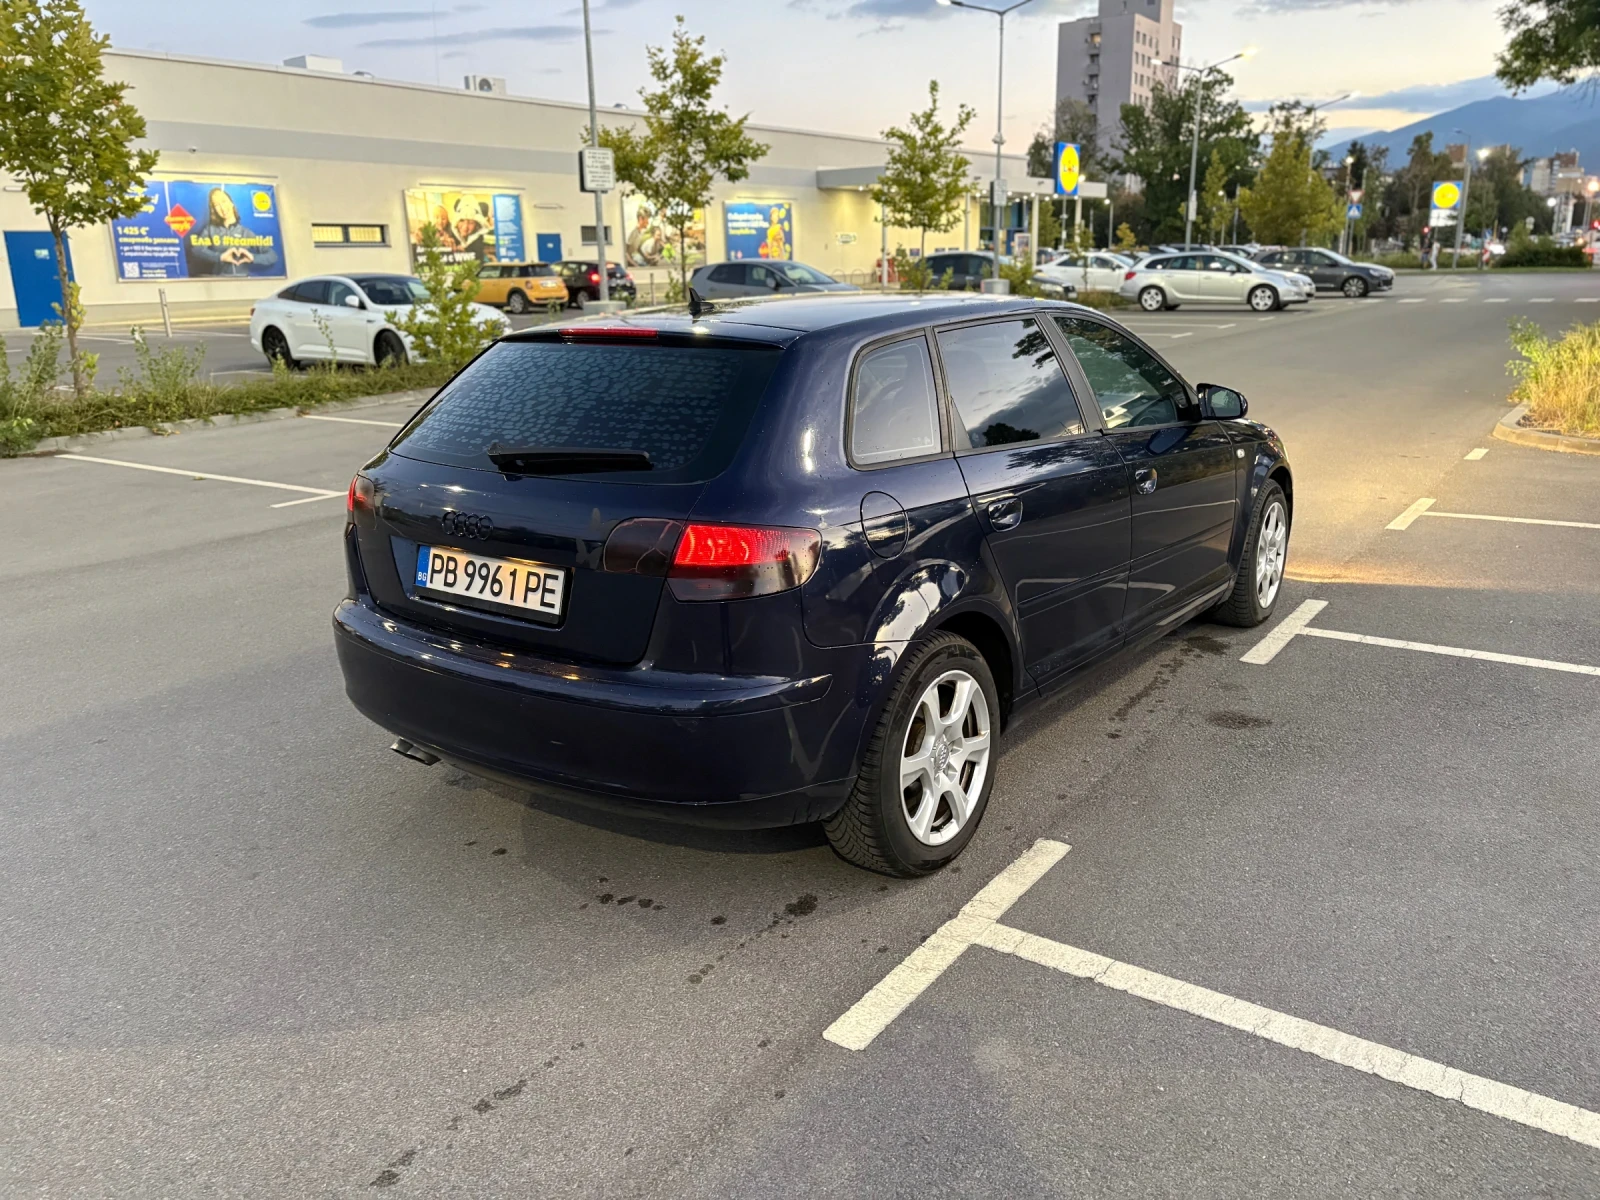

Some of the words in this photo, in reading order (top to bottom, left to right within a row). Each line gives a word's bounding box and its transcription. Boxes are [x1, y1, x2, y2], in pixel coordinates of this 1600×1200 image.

[190, 235, 213, 247] Ела
[223, 235, 273, 247] #teamlidl
[417, 571, 427, 582] BG
[429, 553, 458, 588] PB
[464, 559, 517, 601] 9961
[523, 570, 559, 609] PE
